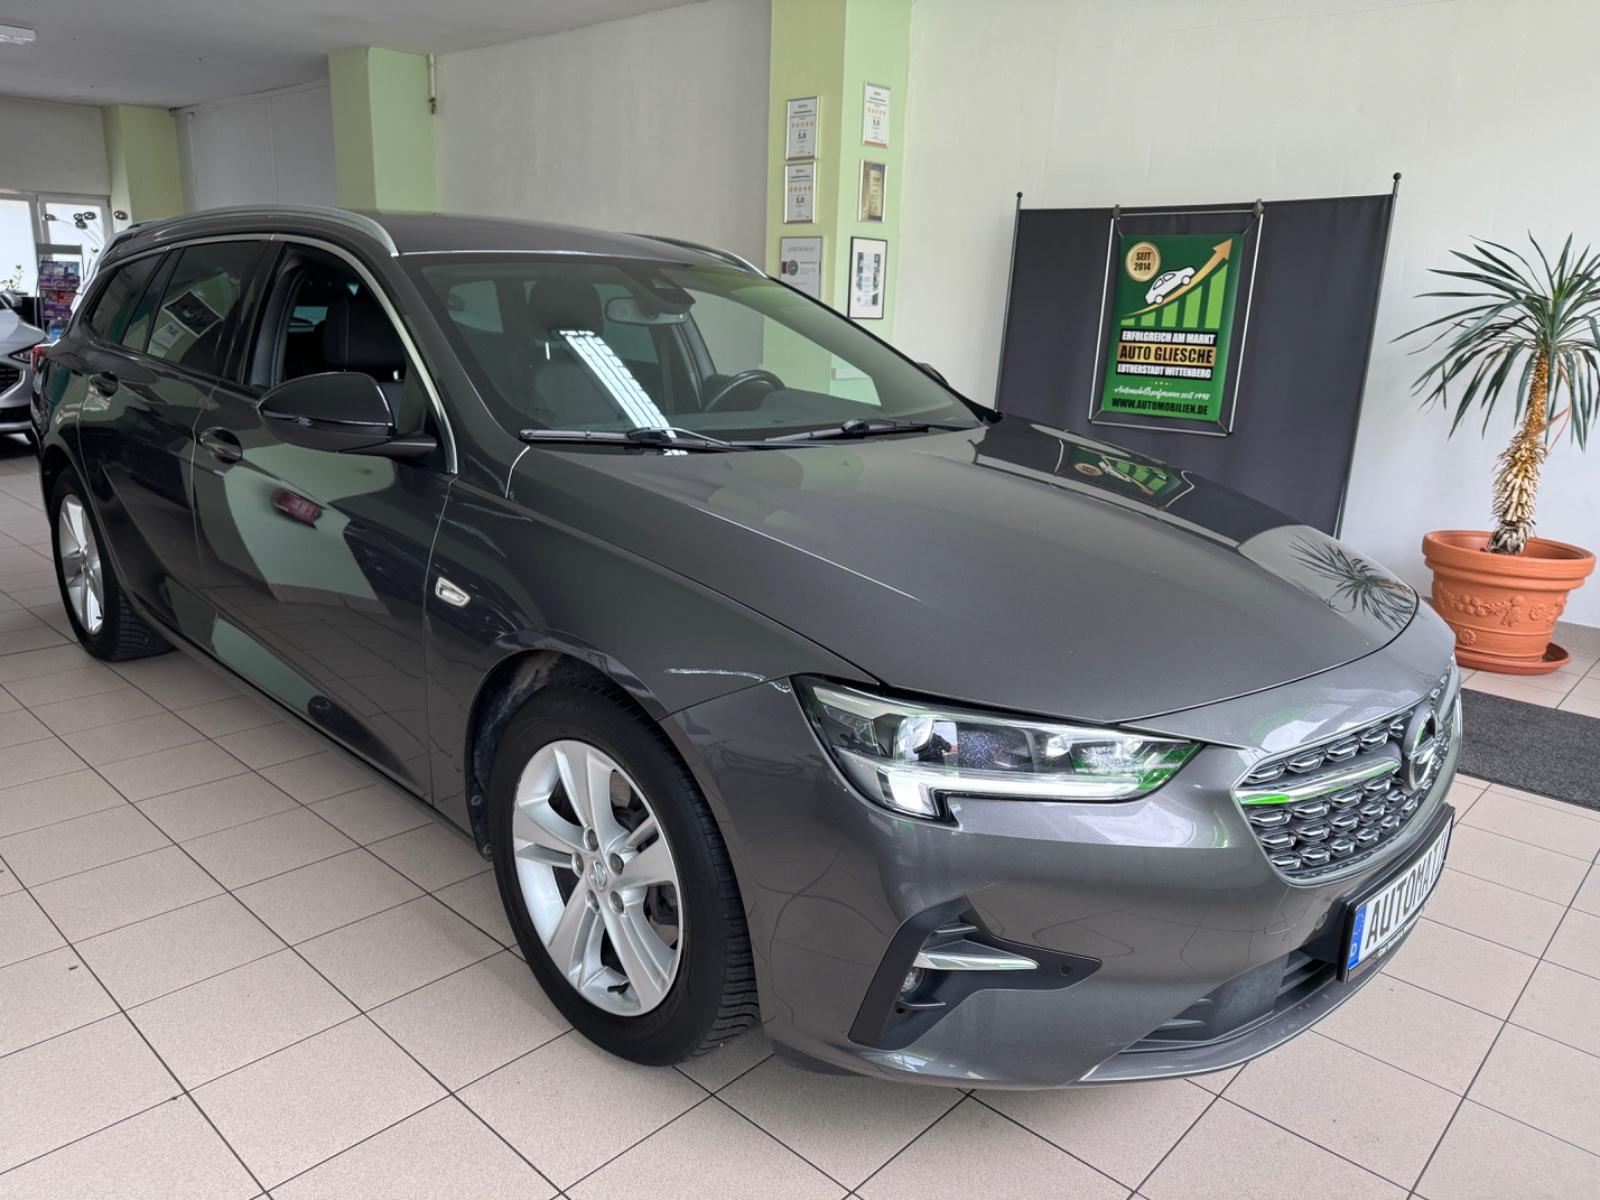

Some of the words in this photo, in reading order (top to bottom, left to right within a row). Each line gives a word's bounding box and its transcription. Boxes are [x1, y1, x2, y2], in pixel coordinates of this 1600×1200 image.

[1136, 251, 1151, 261] SEIT
[1134, 262, 1151, 271] 2014
[1122, 330, 1172, 343] ERFOLGREICH
[1172, 332, 1185, 343] AM
[1186, 333, 1216, 345] MARKT
[1119, 345, 1151, 360] AUTO
[1154, 346, 1213, 363] GLIESCHE
[1117, 363, 1164, 376] LUTHERSTADT
[1164, 366, 1211, 378] WITTENBERG
[1112, 398, 1208, 415] WWW.AUTOMOBILIEN.DE
